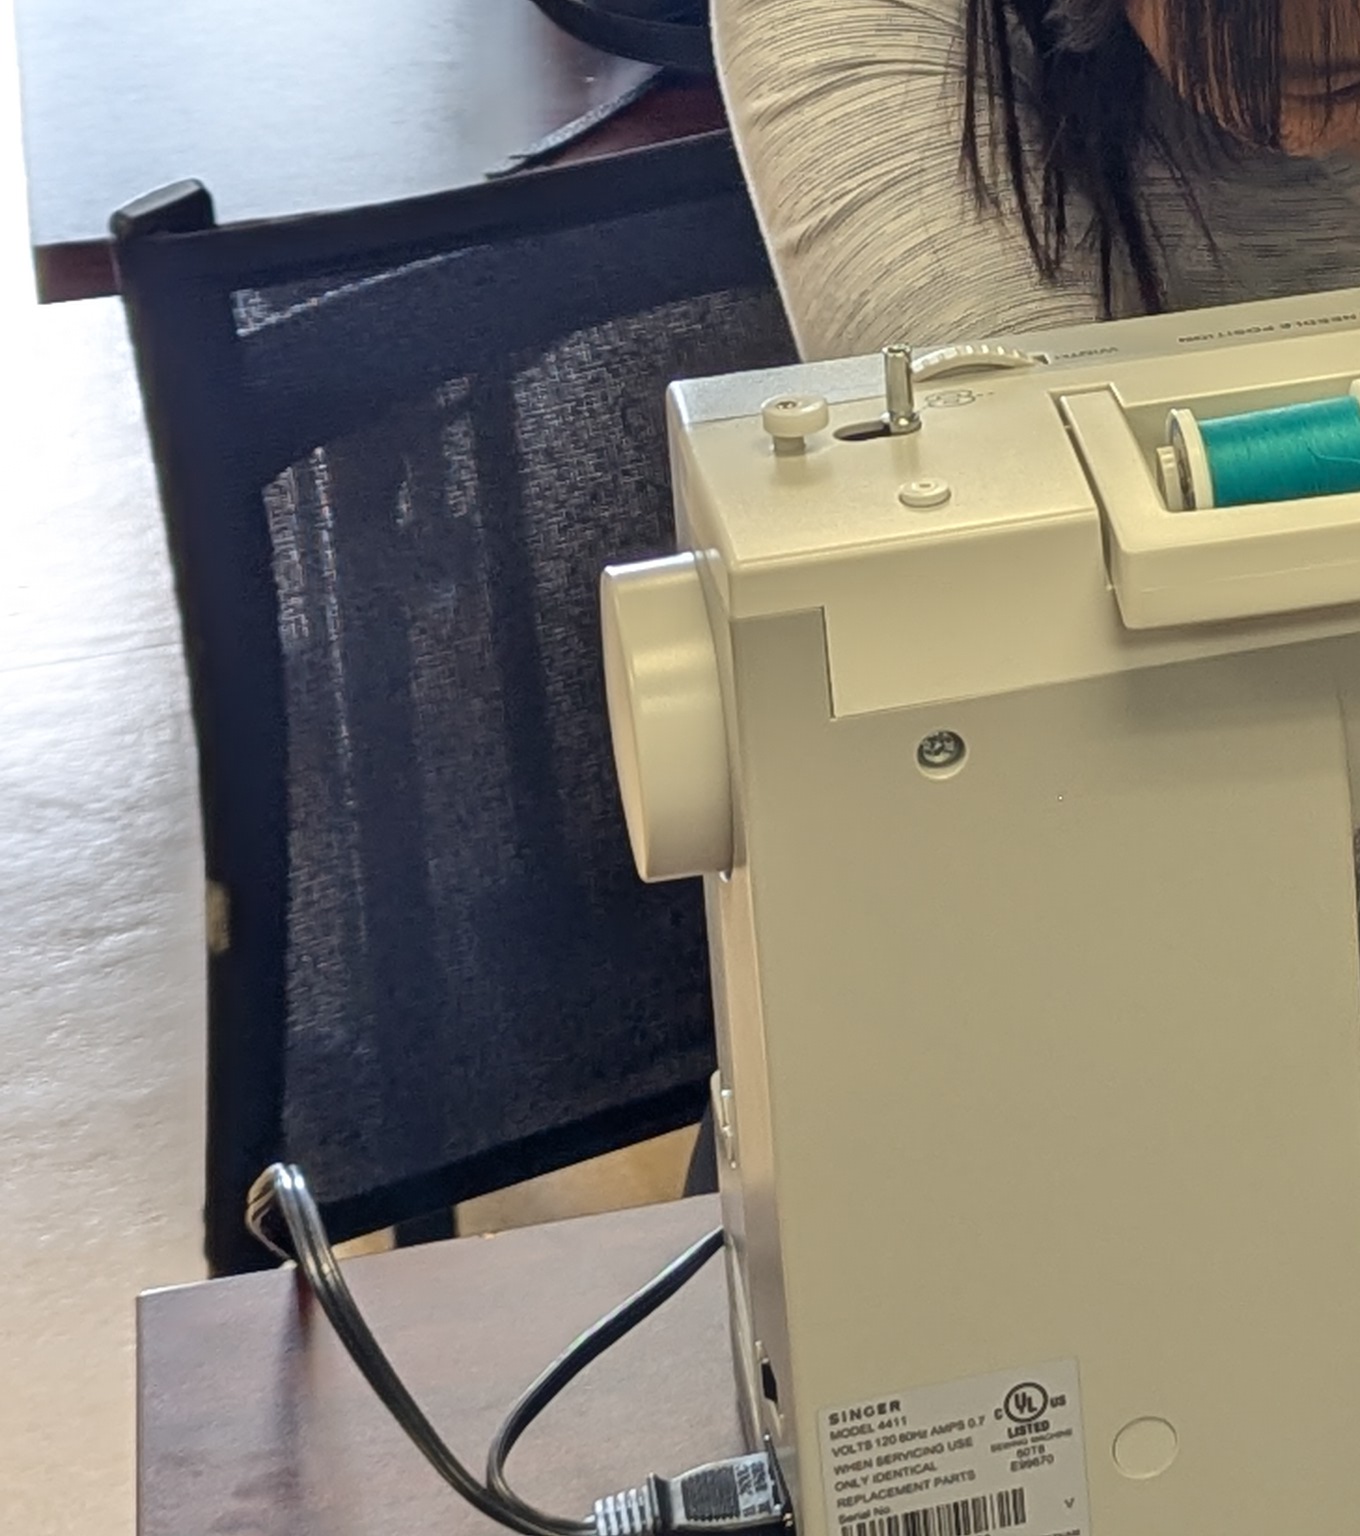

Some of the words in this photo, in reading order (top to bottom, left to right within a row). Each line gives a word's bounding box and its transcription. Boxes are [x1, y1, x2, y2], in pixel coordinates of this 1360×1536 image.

[828, 1400, 901, 1426] SINGER
[830, 1423, 875, 1441] MODEL
[878, 1415, 907, 1430] 4411
[831, 1439, 873, 1458] VOLTS
[876, 1434, 897, 1447] 120
[930, 1419, 965, 1436] AMPS
[1007, 1420, 1050, 1439] LISTED
[833, 1457, 873, 1476] WHEN
[876, 1442, 944, 1467] SERVICING
[947, 1436, 973, 1452] USE
[834, 1475, 869, 1492] ONLY
[872, 1462, 937, 1484] IDENTICAL
[836, 1479, 931, 1508] REPLACEMENT
[934, 1469, 976, 1488] PARTS
